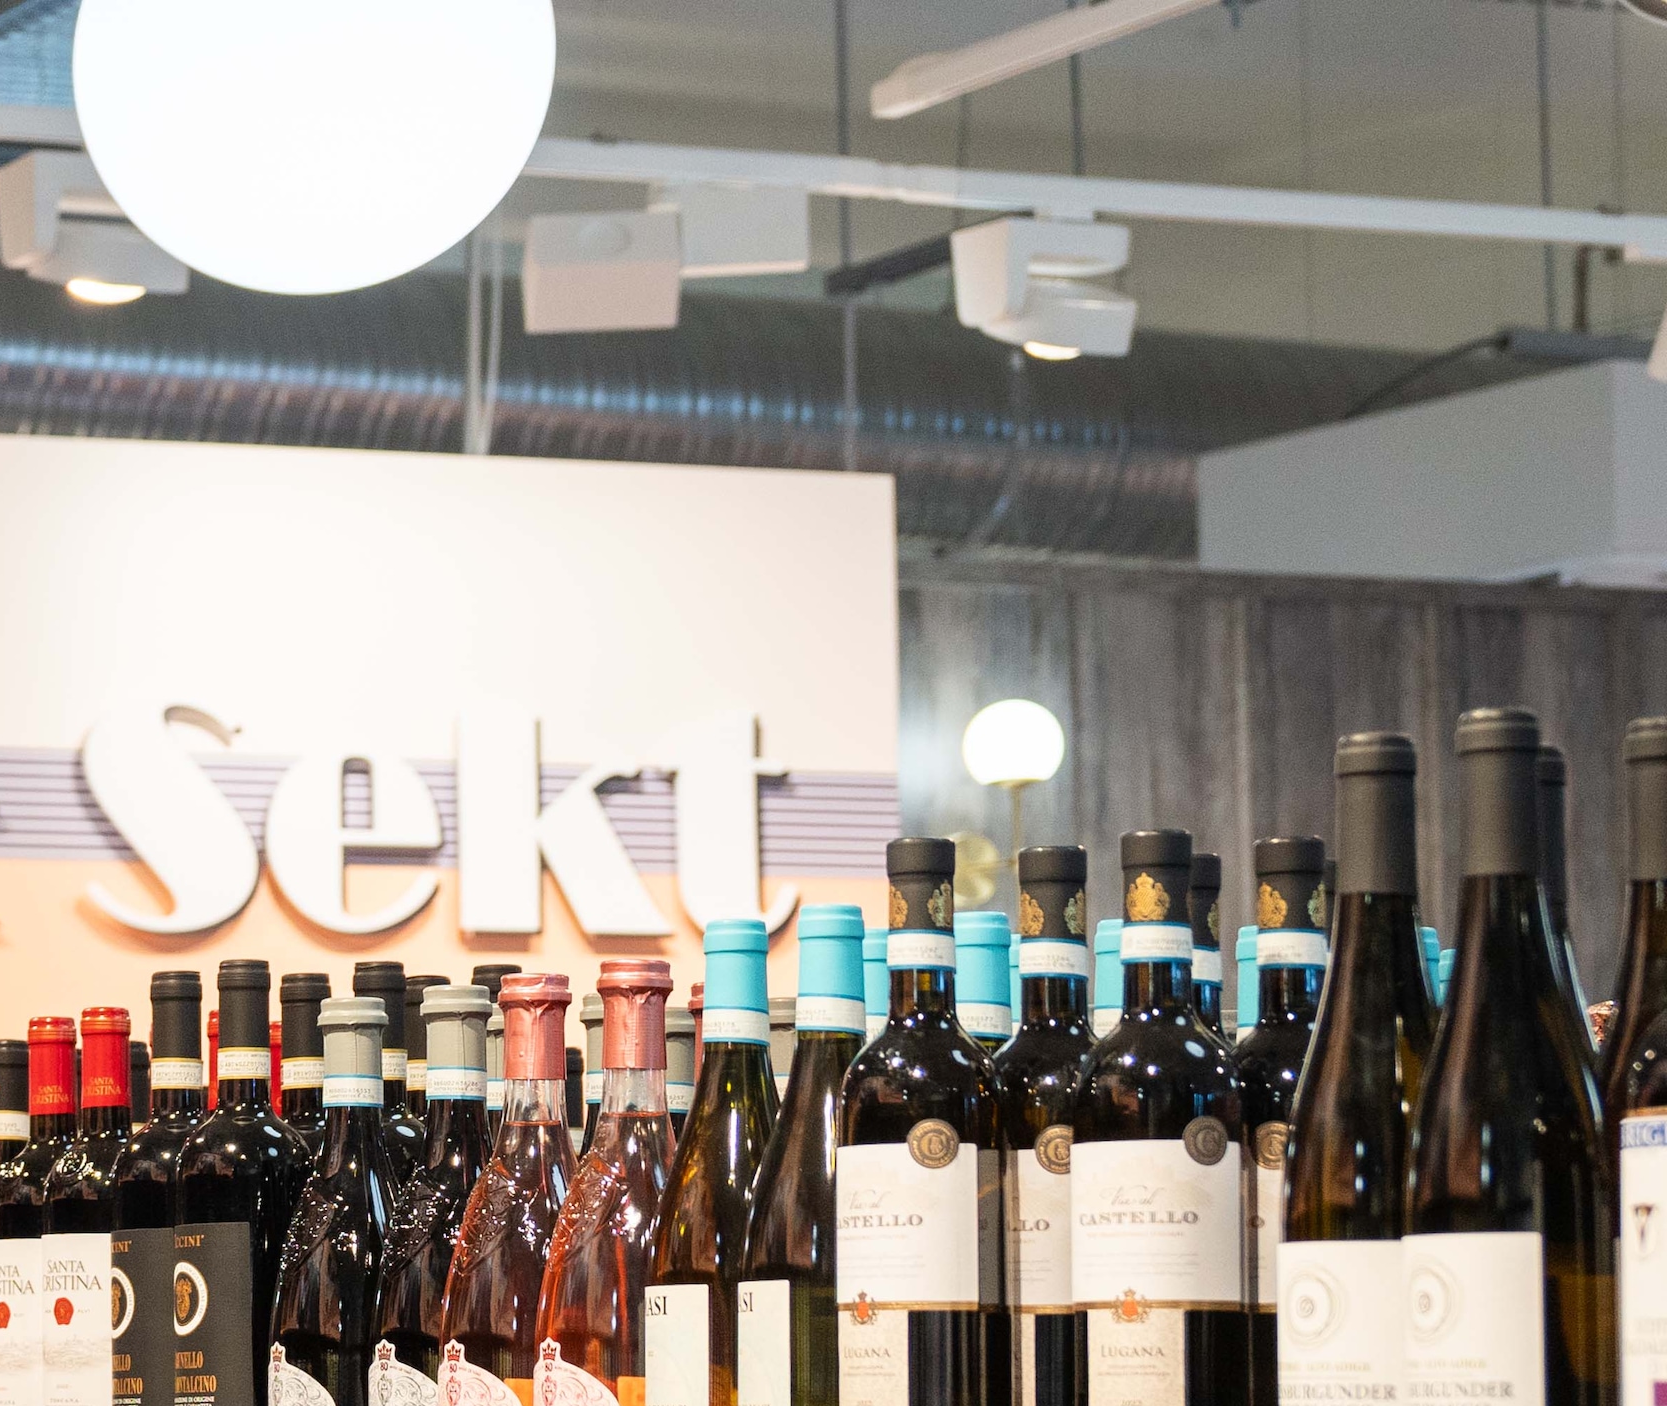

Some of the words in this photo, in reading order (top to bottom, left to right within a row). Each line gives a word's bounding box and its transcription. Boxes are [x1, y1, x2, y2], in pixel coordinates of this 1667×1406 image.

[81, 703, 800, 938] Sekt
[1079, 1210, 1199, 1227] CASTELLO
[47, 1259, 85, 1273] SANTA
[843, 1347, 891, 1359] LUGANA
[1099, 1343, 1167, 1360] LUGANA
